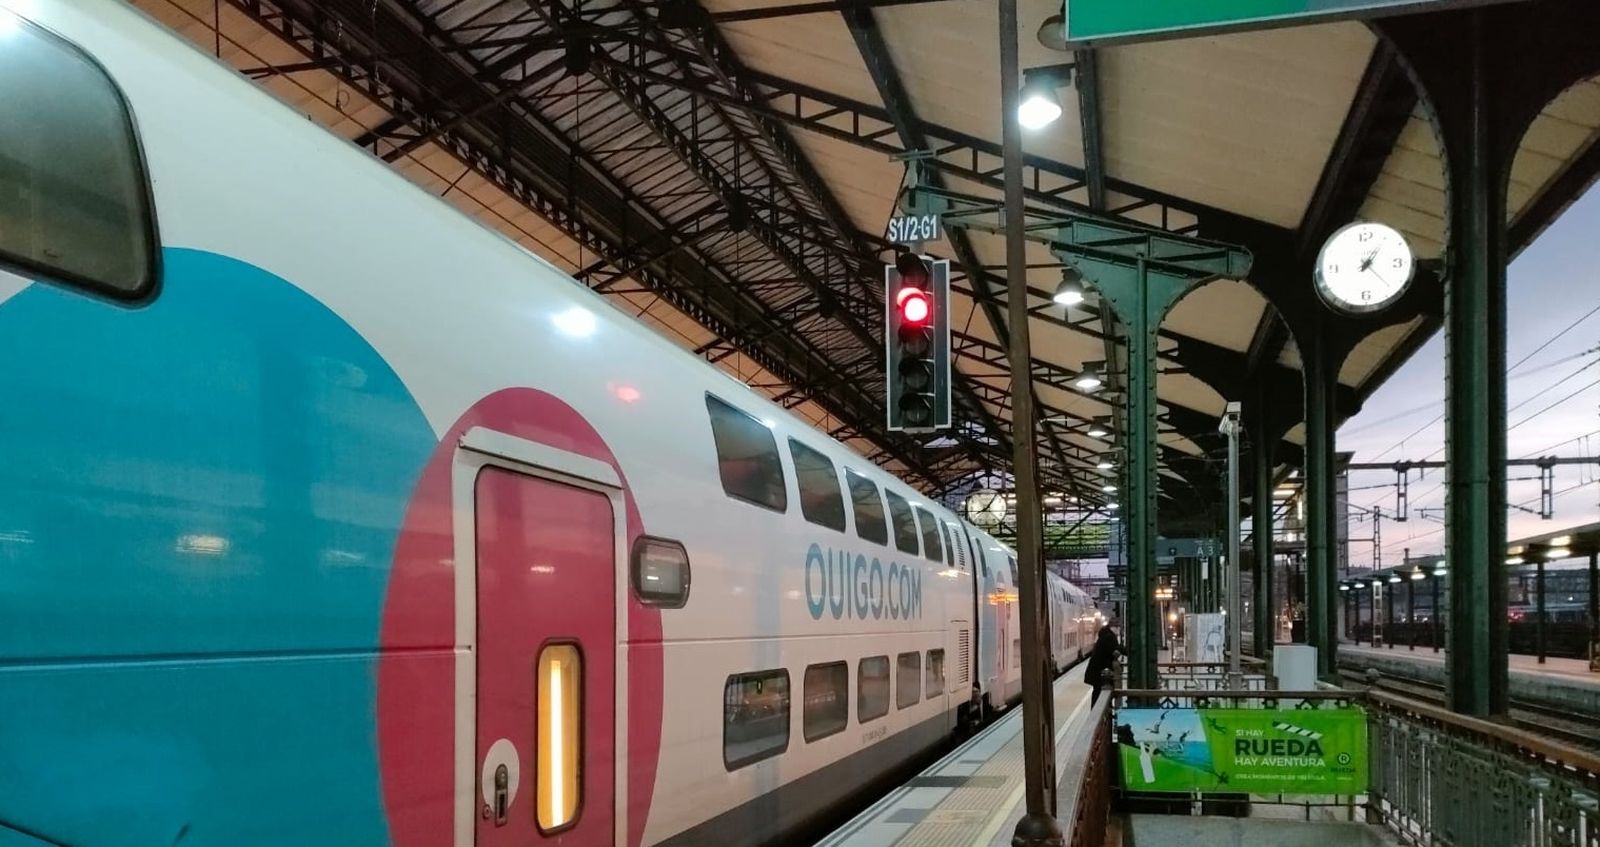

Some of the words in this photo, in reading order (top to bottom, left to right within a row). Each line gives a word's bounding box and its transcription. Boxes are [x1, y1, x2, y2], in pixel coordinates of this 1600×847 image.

[1359, 231, 1373, 242] 12
[1393, 258, 1403, 268] 3
[1361, 291, 1371, 301] 6
[805, 542, 922, 620] OUIGO.COM
[1236, 729, 1244, 737] SI
[1246, 729, 1264, 737] HAY
[1235, 739, 1324, 757] RUEDA
[1235, 757, 1258, 766] HAY
[1260, 757, 1326, 768] AVENTURA
